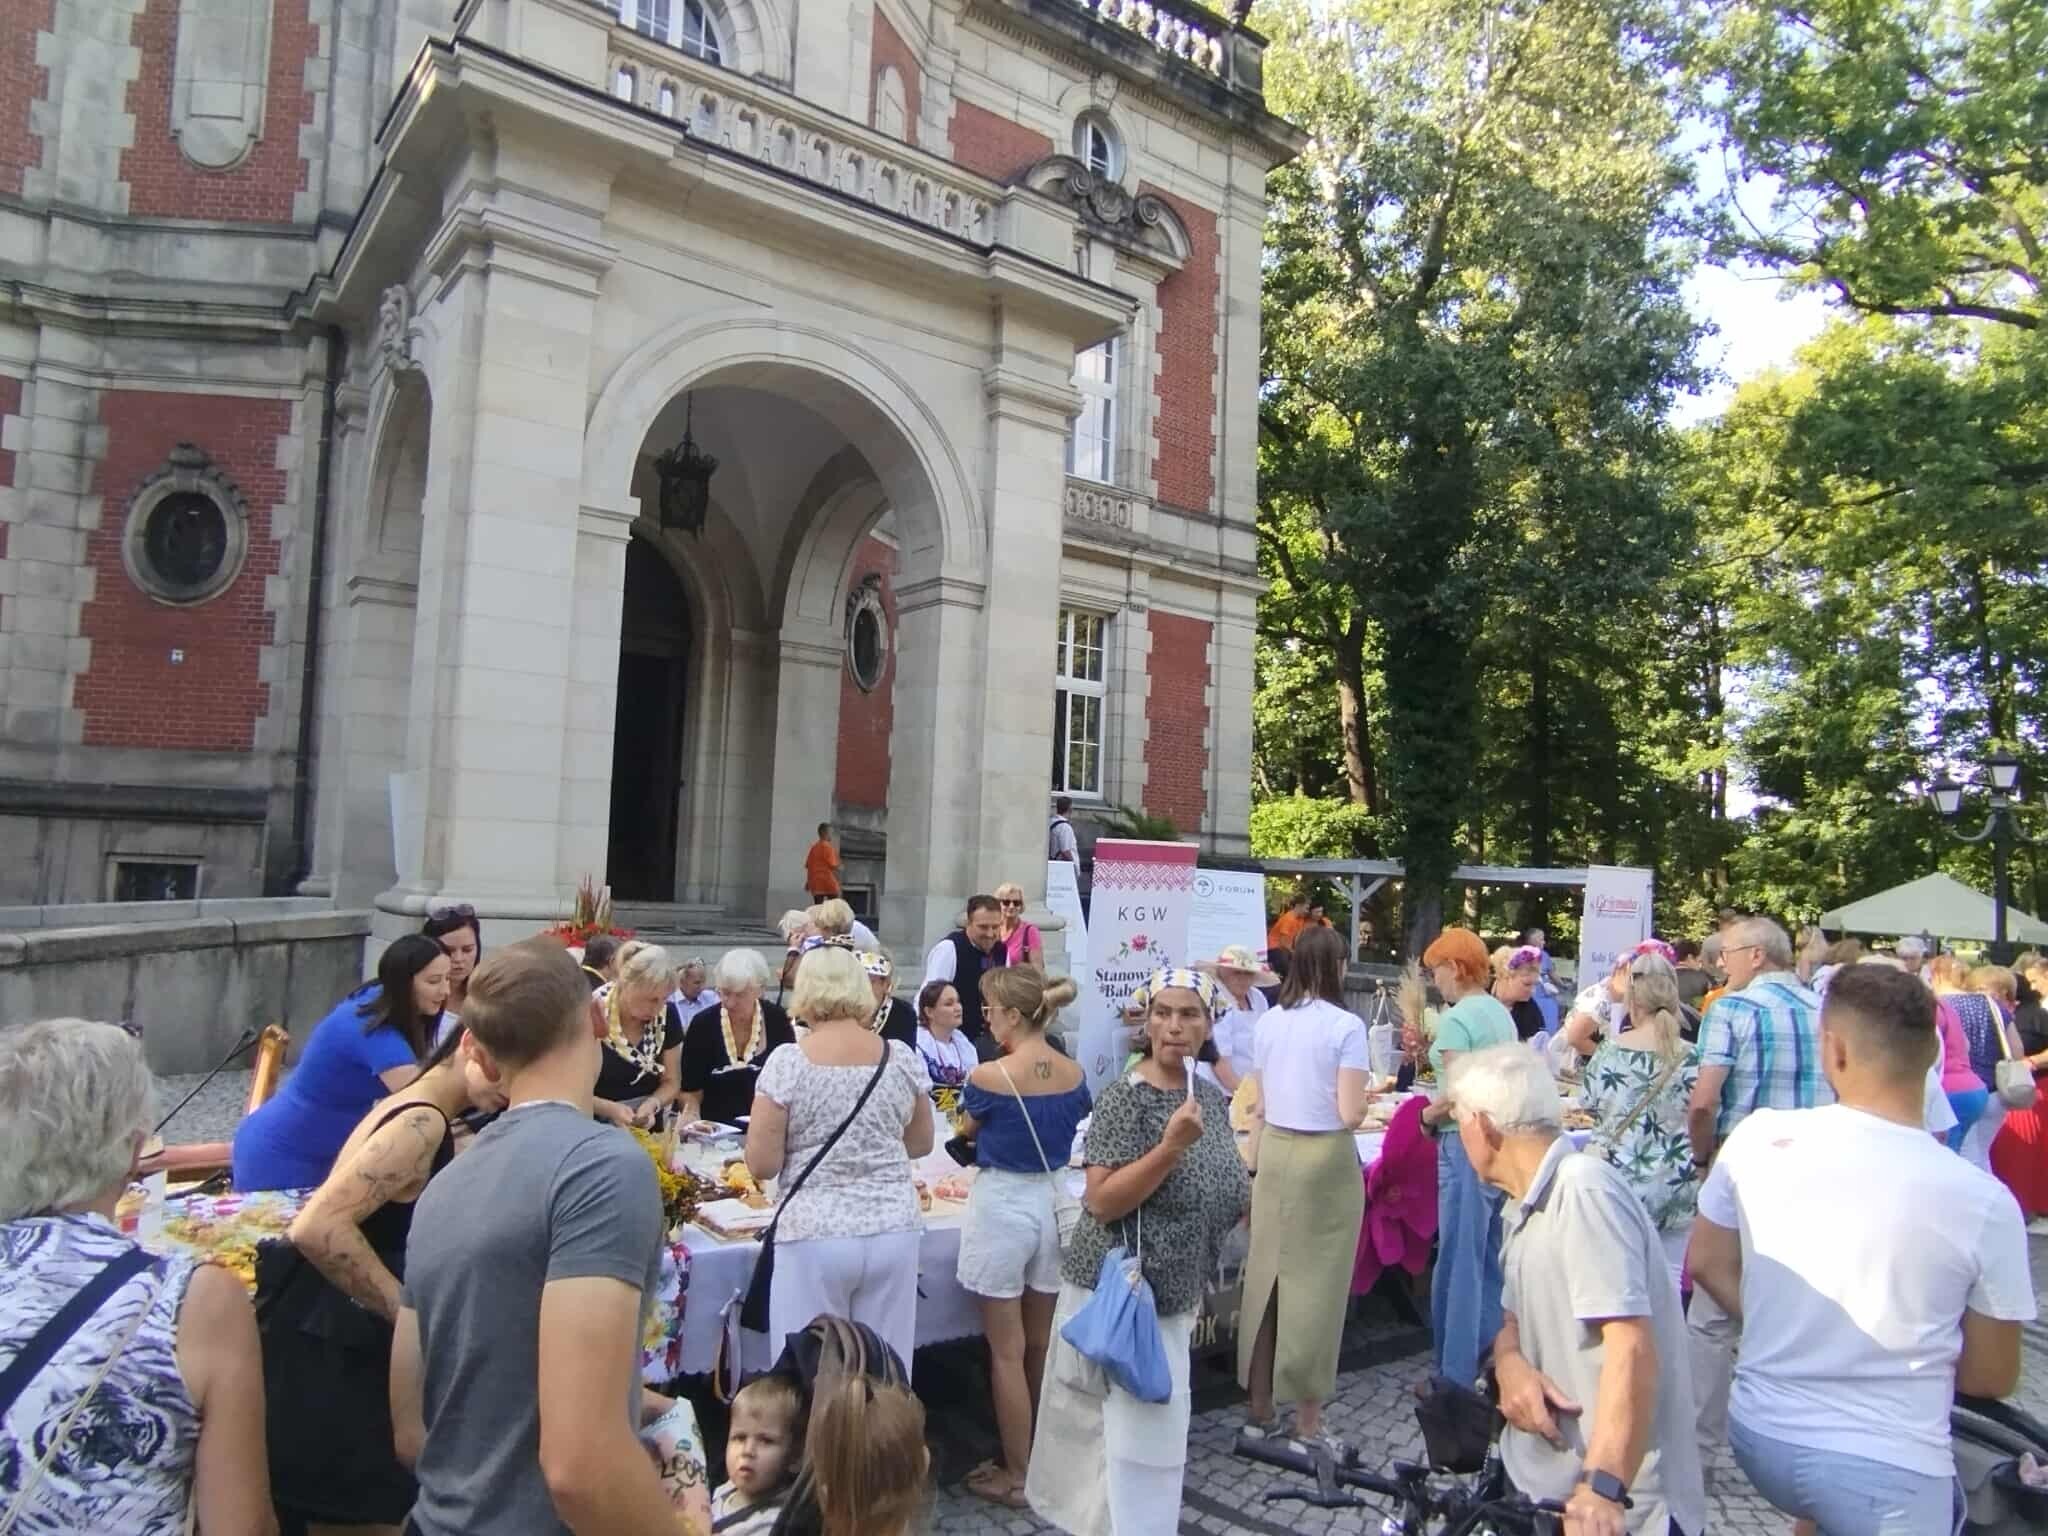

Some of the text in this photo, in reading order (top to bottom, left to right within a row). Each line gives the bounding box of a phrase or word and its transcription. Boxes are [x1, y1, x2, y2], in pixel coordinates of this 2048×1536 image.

[1218, 885, 1255, 895] FORUM
[1095, 967, 1151, 981] Stanowi
[1104, 983, 1136, 998] Bab
